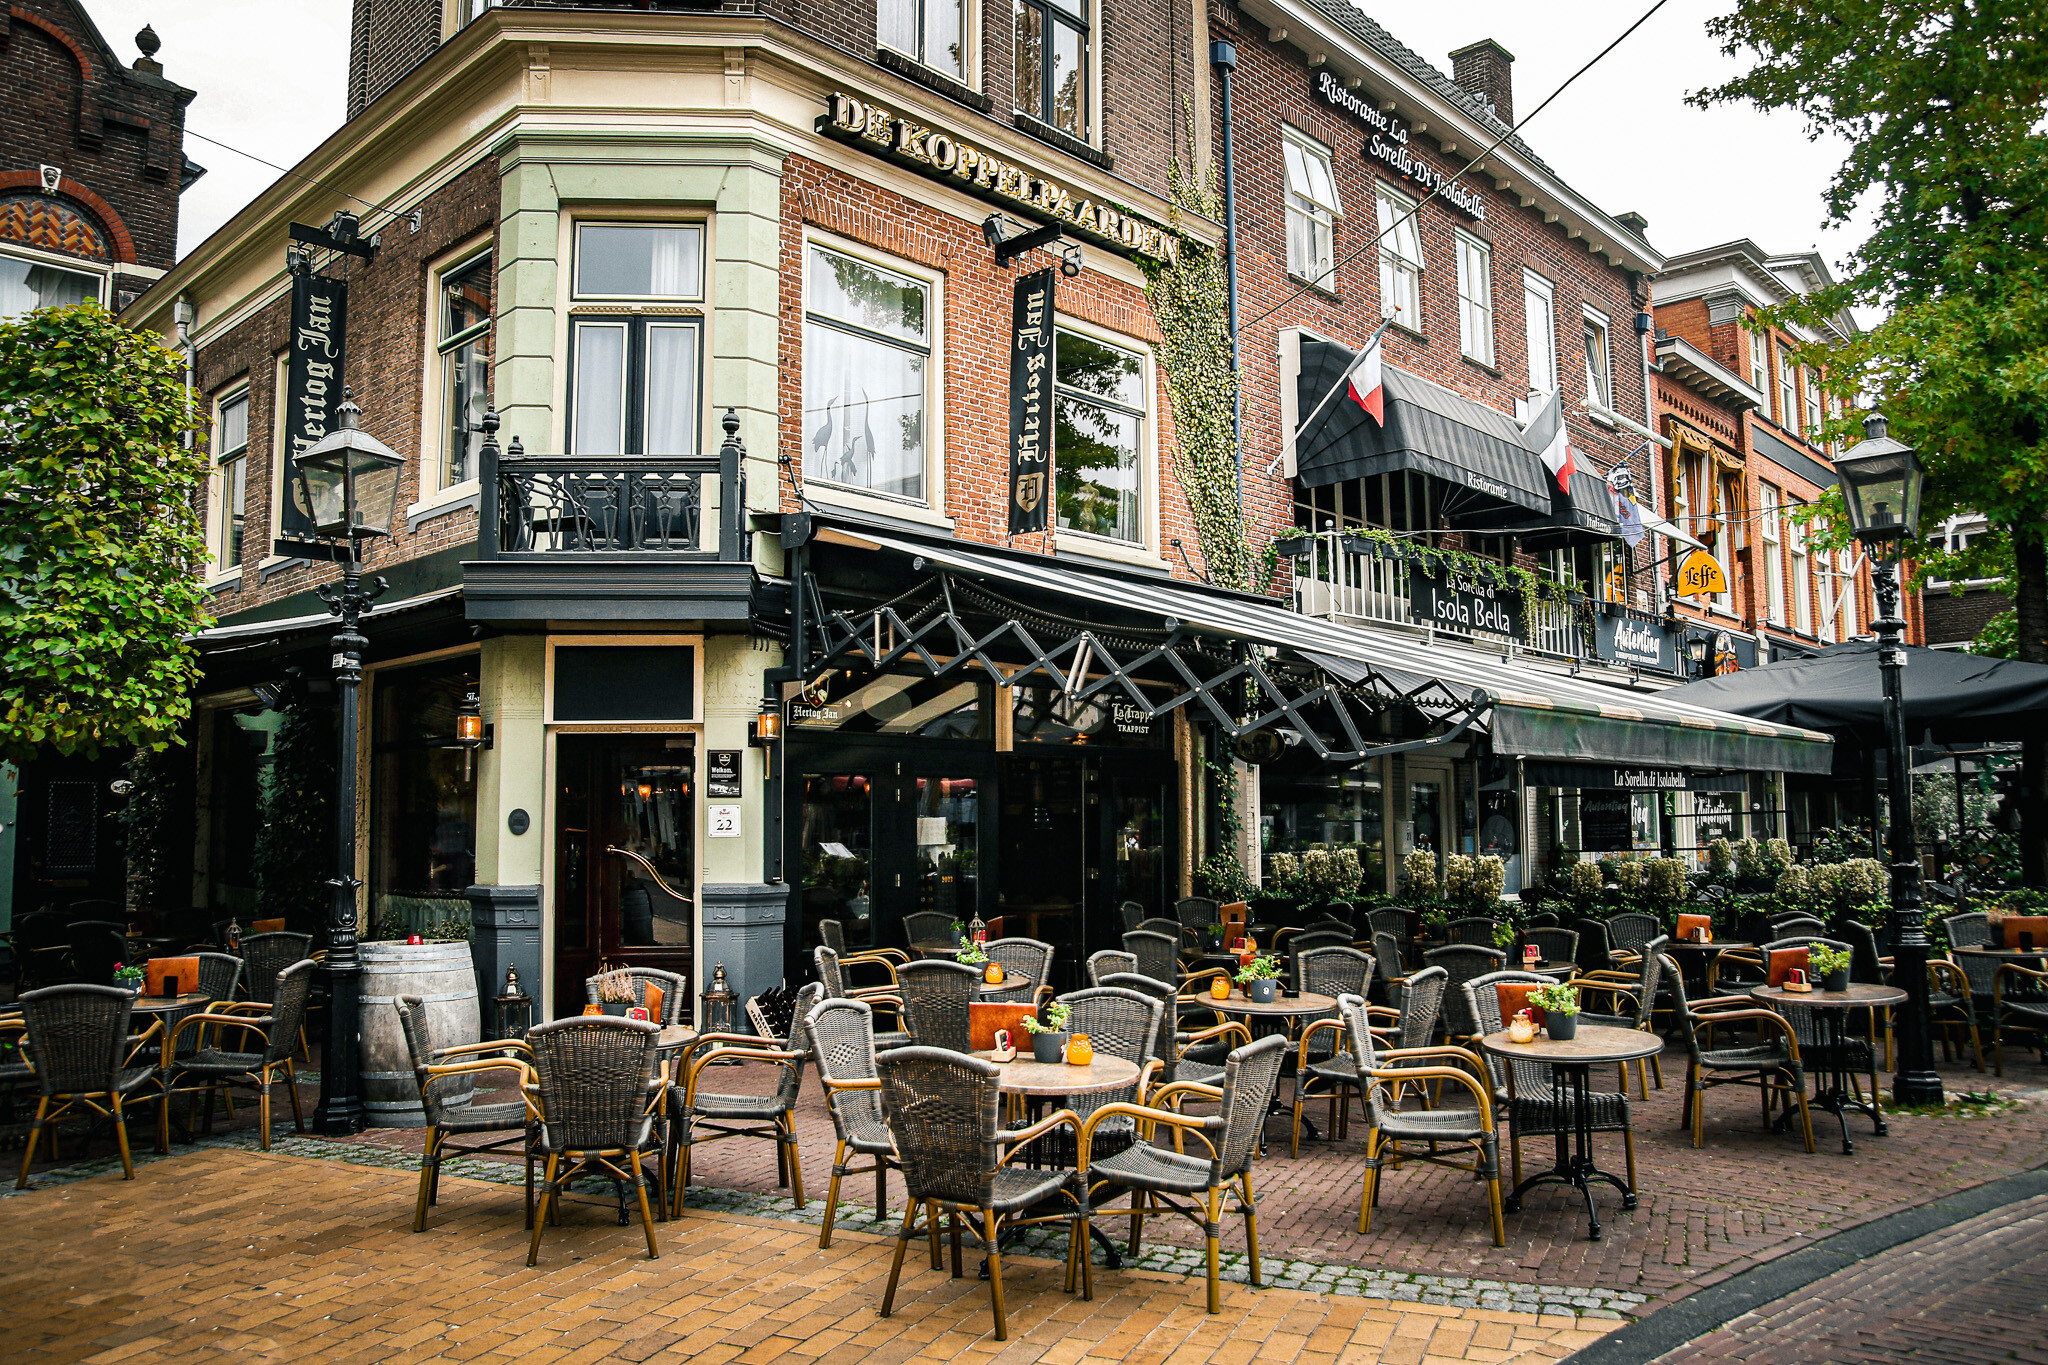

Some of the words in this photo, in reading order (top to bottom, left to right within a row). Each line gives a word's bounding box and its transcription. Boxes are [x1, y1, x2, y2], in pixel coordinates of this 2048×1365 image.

[1319, 72, 1387, 131] Ristorante
[1389, 119, 1408, 145] La
[833, 92, 893, 147] DE
[896, 118, 1180, 266] KOPPELPAARDEN
[1370, 134, 1413, 175] Sorella
[1415, 161, 1432, 186] Di
[1434, 173, 1486, 221] Isolabella
[297, 295, 338, 358] Jan
[1018, 289, 1049, 350] Jan
[1017, 353, 1047, 464] Hertog
[1467, 471, 1508, 499] Ristorante
[1586, 514, 1612, 534] Italiano
[1446, 573, 1456, 589] La
[1486, 583, 1495, 599] di
[1684, 564, 1717, 589] Leffe
[1432, 587, 1469, 626] Isola
[1474, 598, 1510, 634] Bella
[793, 705, 821, 720] Hertog
[822, 707, 838, 721] Jan
[1112, 703, 1124, 724] La
[1124, 704, 1151, 723] Trapp
[1117, 724, 1149, 734] TRAPPIST
[1614, 769, 1624, 786] La
[1624, 770, 1648, 787] Sorella
[1649, 770, 1656, 787] di
[1657, 771, 1686, 788] Isolabella
[716, 819, 733, 831] 22
[1263, 987, 1270, 995] 9
